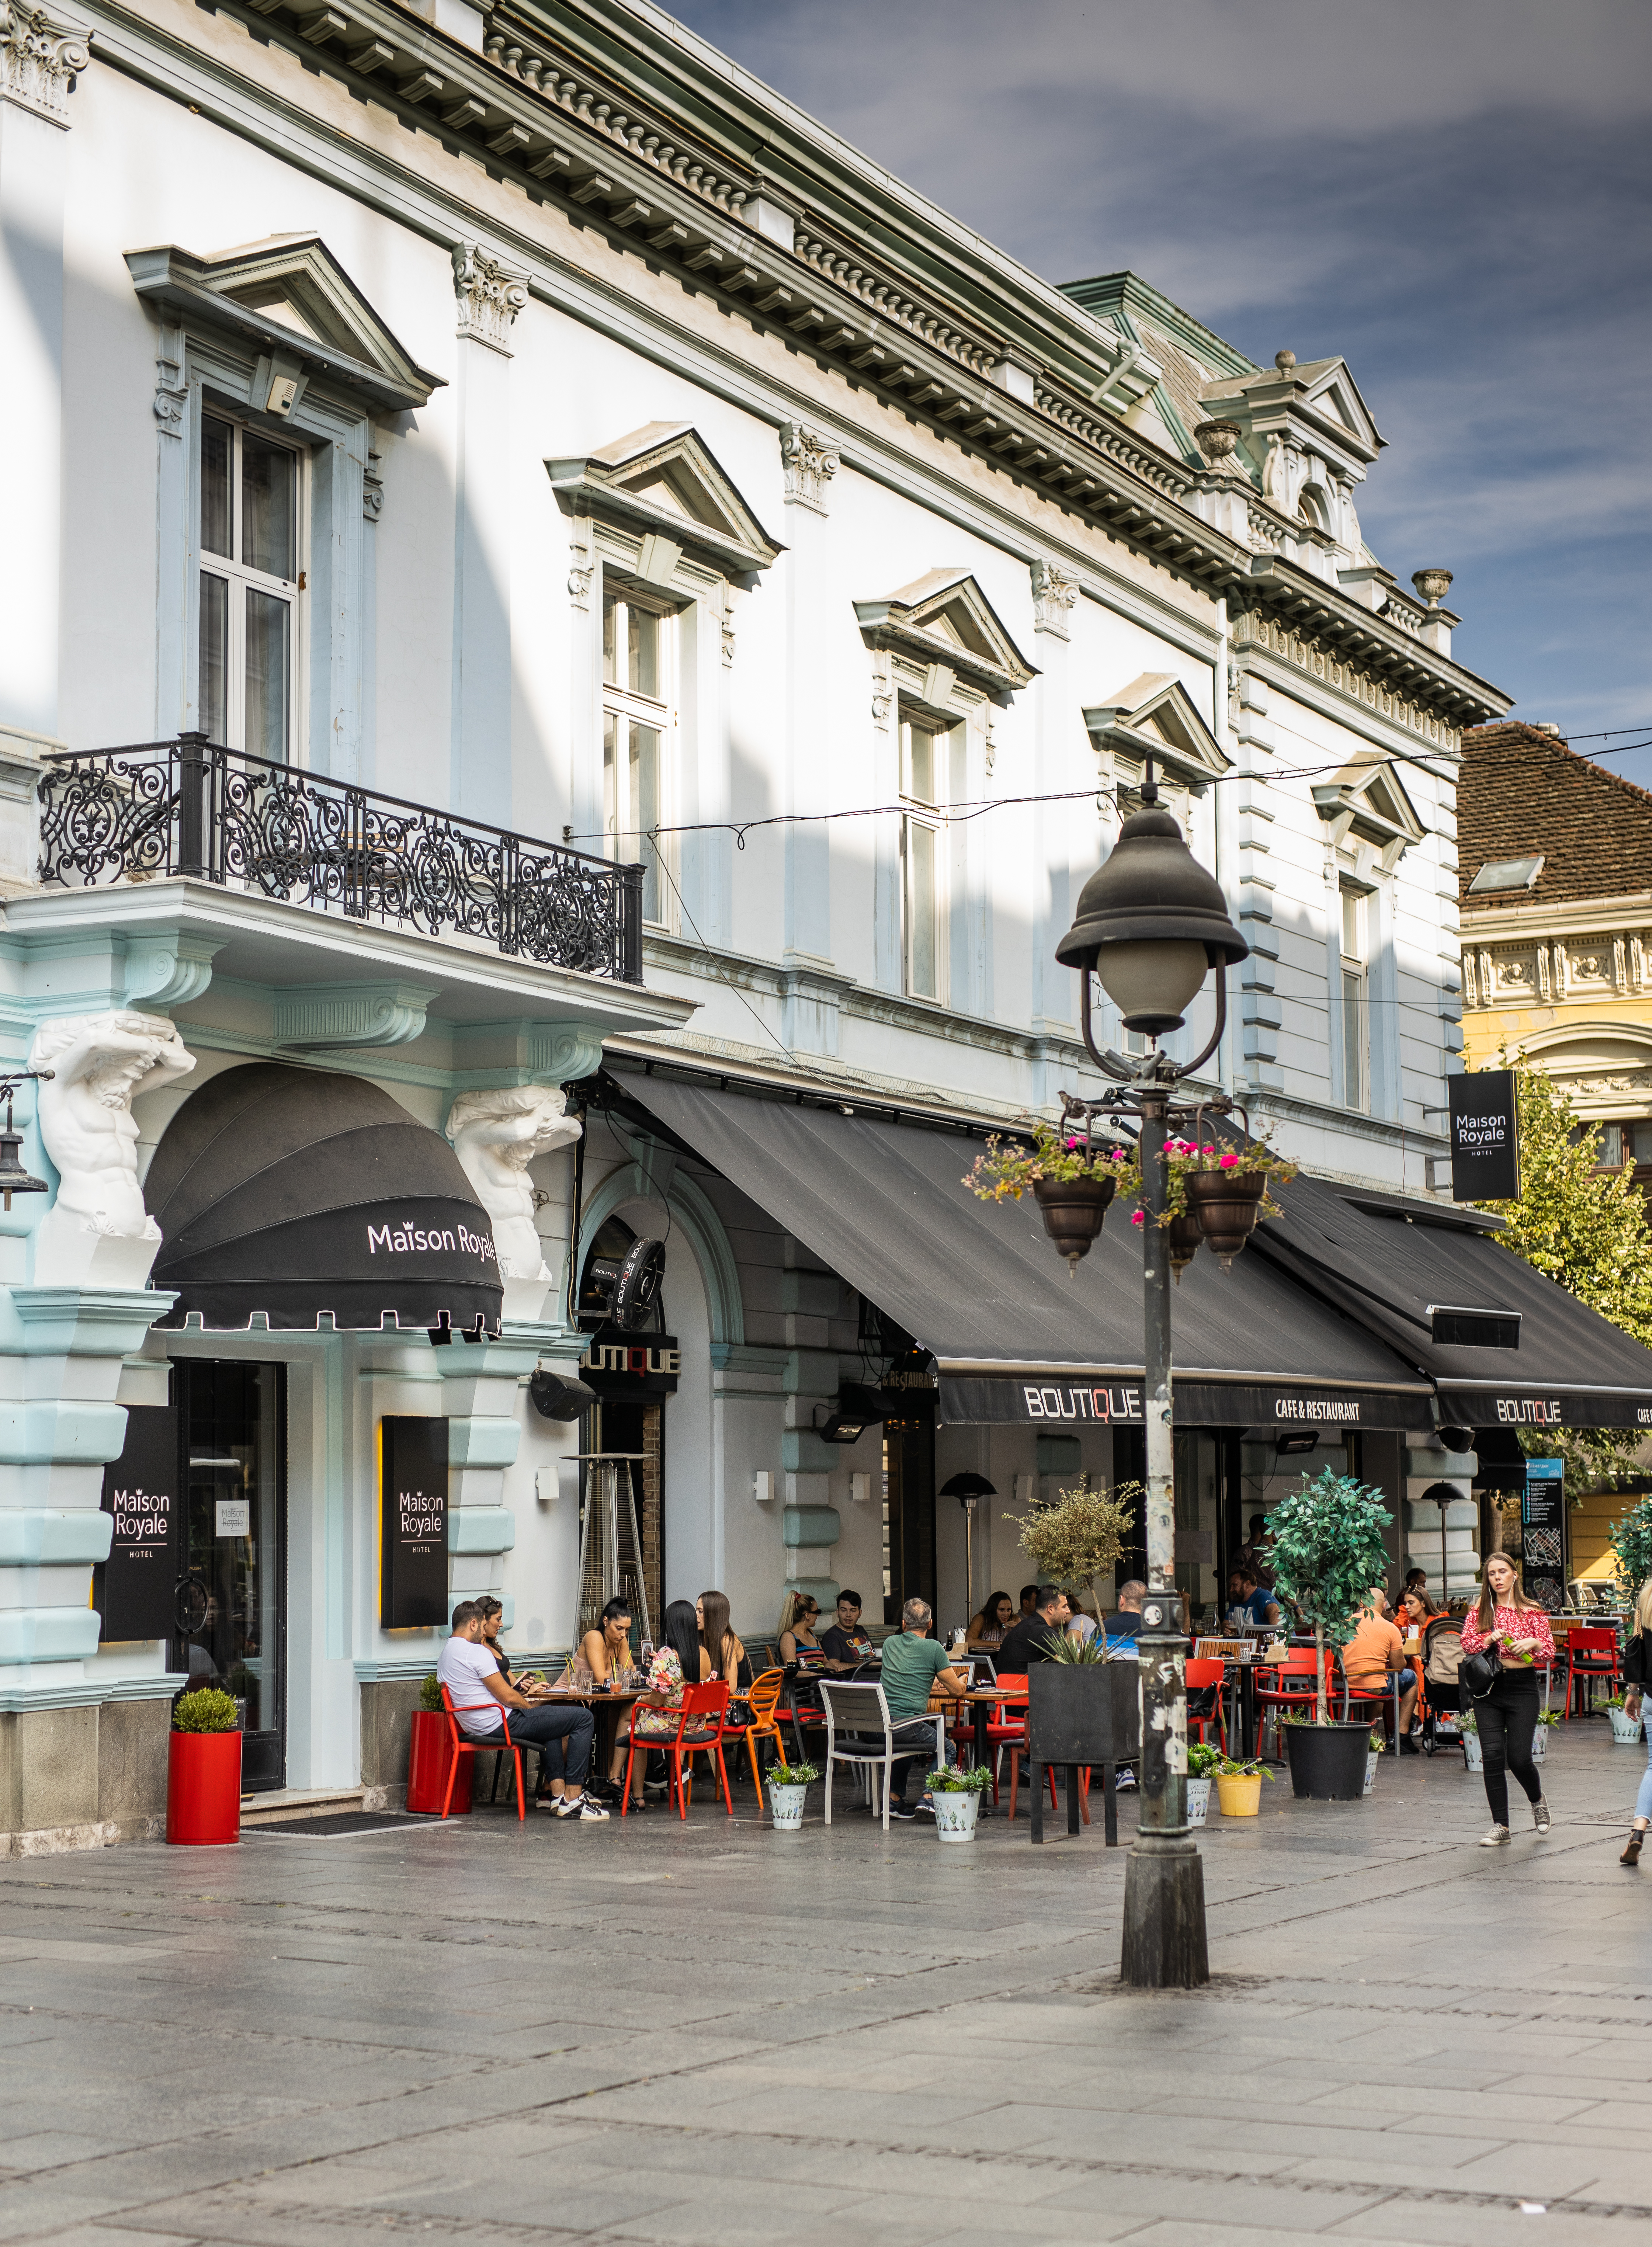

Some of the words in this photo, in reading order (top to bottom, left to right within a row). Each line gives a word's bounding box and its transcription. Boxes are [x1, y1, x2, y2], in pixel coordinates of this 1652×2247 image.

[1457, 1115, 1506, 1129] Maison
[1459, 1127, 1504, 1145] Royale
[367, 1221, 455, 1253] Maison
[457, 1225, 496, 1262] Royale
[618, 1262, 633, 1303] BOUTIQUE
[579, 1344, 681, 1377] UTIQUE
[891, 1370, 934, 1392] RESTAURAN
[1024, 1387, 1142, 1424] BOUTIQUE
[1276, 1399, 1298, 1418] CAFE
[1299, 1400, 1305, 1418] &
[1306, 1401, 1359, 1420] RESTAURANT
[1496, 1399, 1561, 1427] BOUTIQUE
[1637, 1408, 1651, 1423] CAFE
[114, 1489, 169, 1511] Maison
[400, 1491, 443, 1511] Maison
[222, 1508, 244, 1518] Maison
[223, 1518, 243, 1529] Royale
[116, 1513, 167, 1540] Royale
[402, 1513, 441, 1537] Royale
